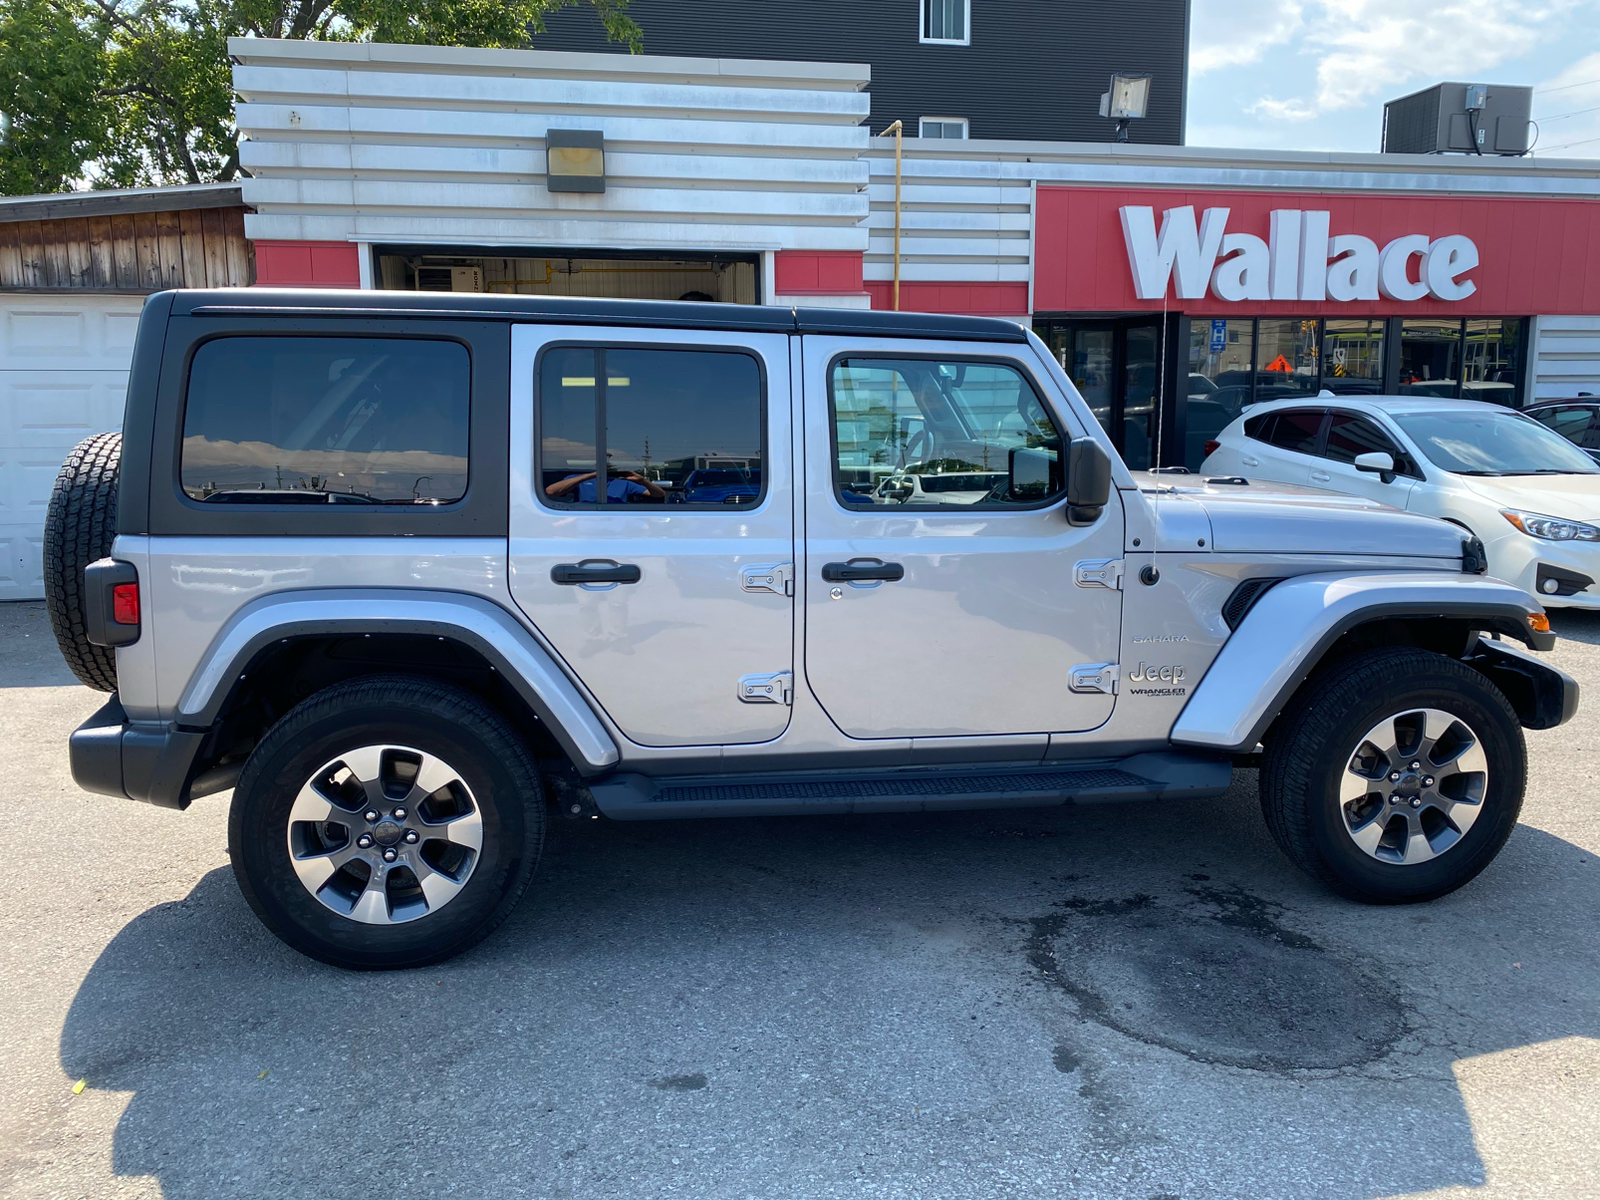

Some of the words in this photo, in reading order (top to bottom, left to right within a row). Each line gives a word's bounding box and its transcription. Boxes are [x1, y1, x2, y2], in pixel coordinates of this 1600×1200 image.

[1118, 205, 1480, 302] Wallace
[1133, 635, 1190, 644] SAHARA
[1129, 661, 1187, 685] Jeep
